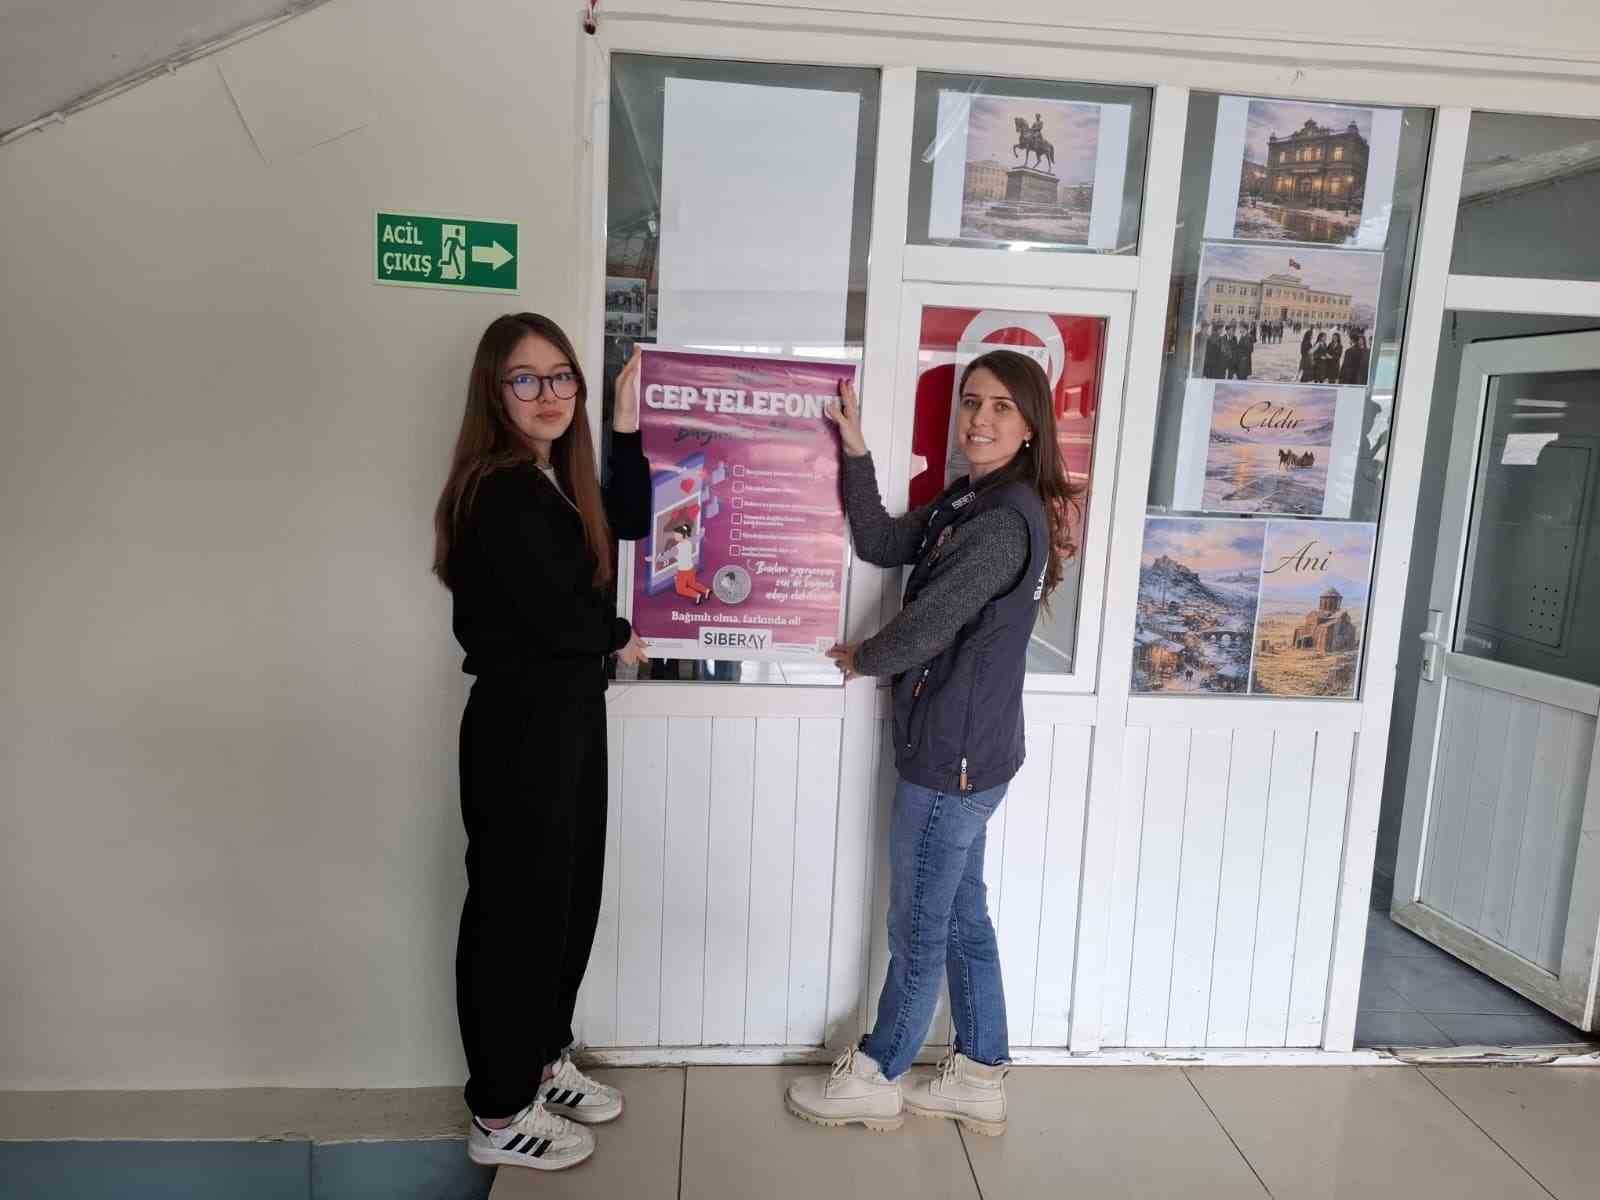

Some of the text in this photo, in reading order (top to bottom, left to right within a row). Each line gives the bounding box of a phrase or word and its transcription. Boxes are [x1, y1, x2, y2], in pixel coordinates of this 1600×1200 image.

[382, 221, 423, 245] ACİL
[383, 252, 432, 277] ÇIKIŞ
[645, 384, 698, 411] CEP
[1264, 541, 1332, 573] Ani
[671, 611, 711, 624] Bağımlı
